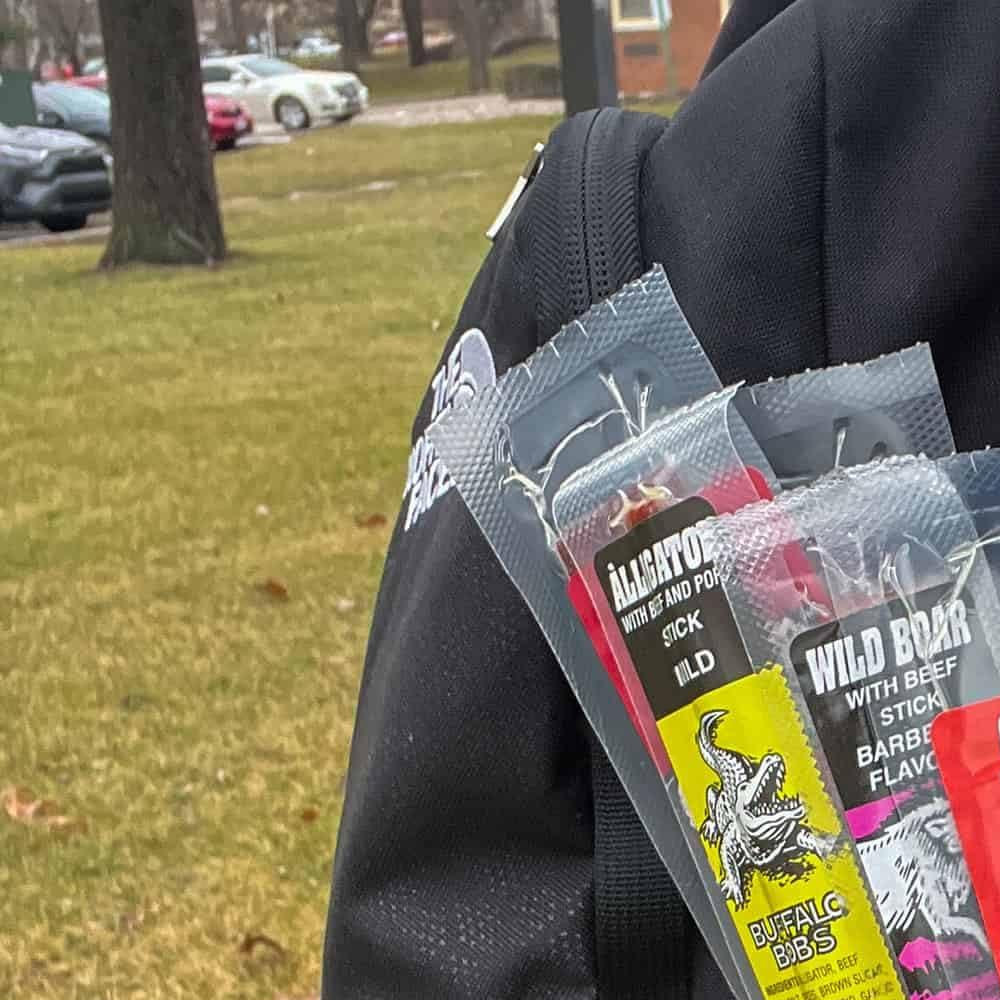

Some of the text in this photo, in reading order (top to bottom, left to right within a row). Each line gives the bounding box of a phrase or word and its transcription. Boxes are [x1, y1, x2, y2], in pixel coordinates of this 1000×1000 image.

[621, 606, 649, 634] WITH
[664, 579, 693, 609] AND
[805, 599, 972, 696] WILD BOAR
[845, 655, 958, 710] WITH BEEF
[880, 690, 943, 726] STICK
